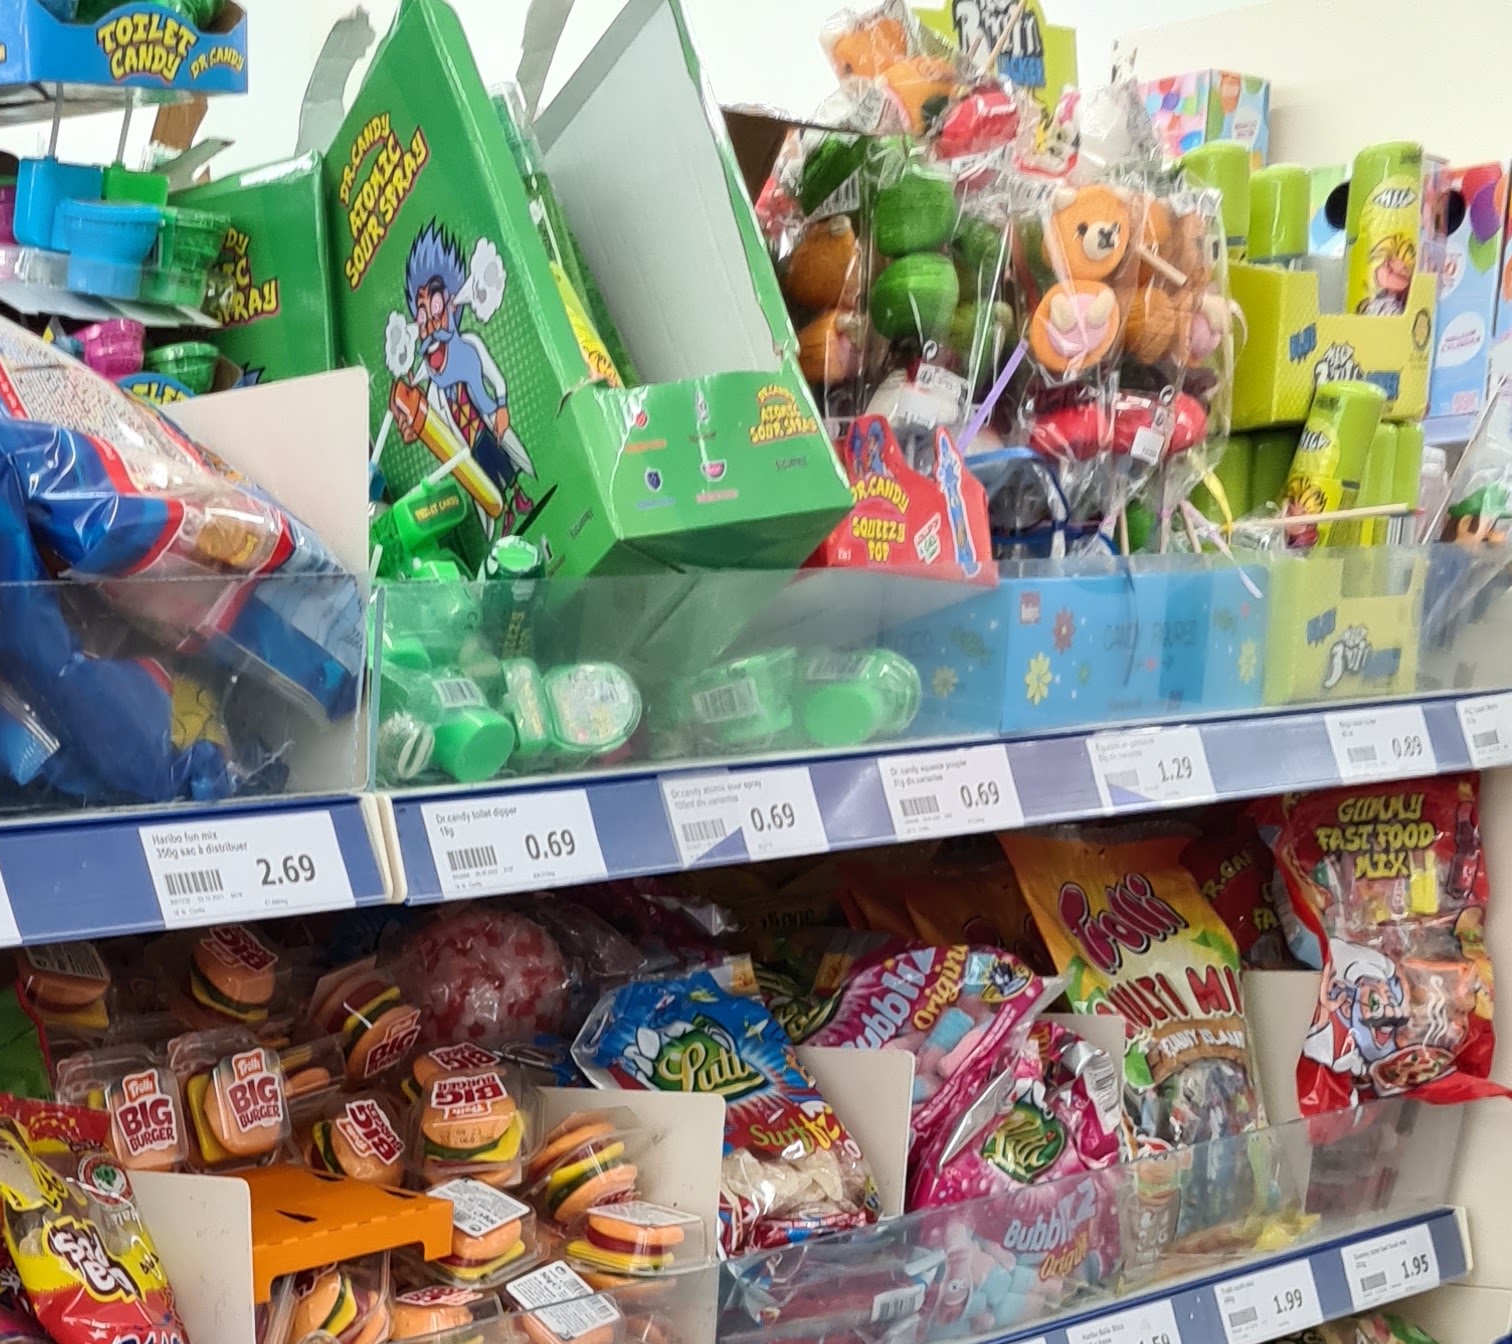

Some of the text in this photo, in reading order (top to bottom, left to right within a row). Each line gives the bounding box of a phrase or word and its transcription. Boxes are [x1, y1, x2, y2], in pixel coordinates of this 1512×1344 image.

[96, 11, 200, 55] TOILET
[111, 40, 182, 82] CANDY
[349, 133, 403, 238] ATOMIC
[344, 127, 429, 290] SOUR SPRAY
[1157, 756, 1193, 783] 1.29
[959, 780, 1000, 809] 0.69
[749, 800, 796, 833] 0.69
[152, 832, 181, 847] Haribo
[524, 828, 576, 861] 0.69
[1375, 823, 1435, 851] FOOD
[256, 853, 316, 888] 2.69
[1353, 852, 1412, 881] MIX
[229, 1078, 279, 1110] BIG
[118, 1099, 174, 1137] BIG
[238, 1101, 282, 1129] BURGER
[128, 1123, 177, 1153] BURGER
[1400, 1254, 1430, 1279] 1.95
[1273, 1288, 1303, 1314] 1.99
